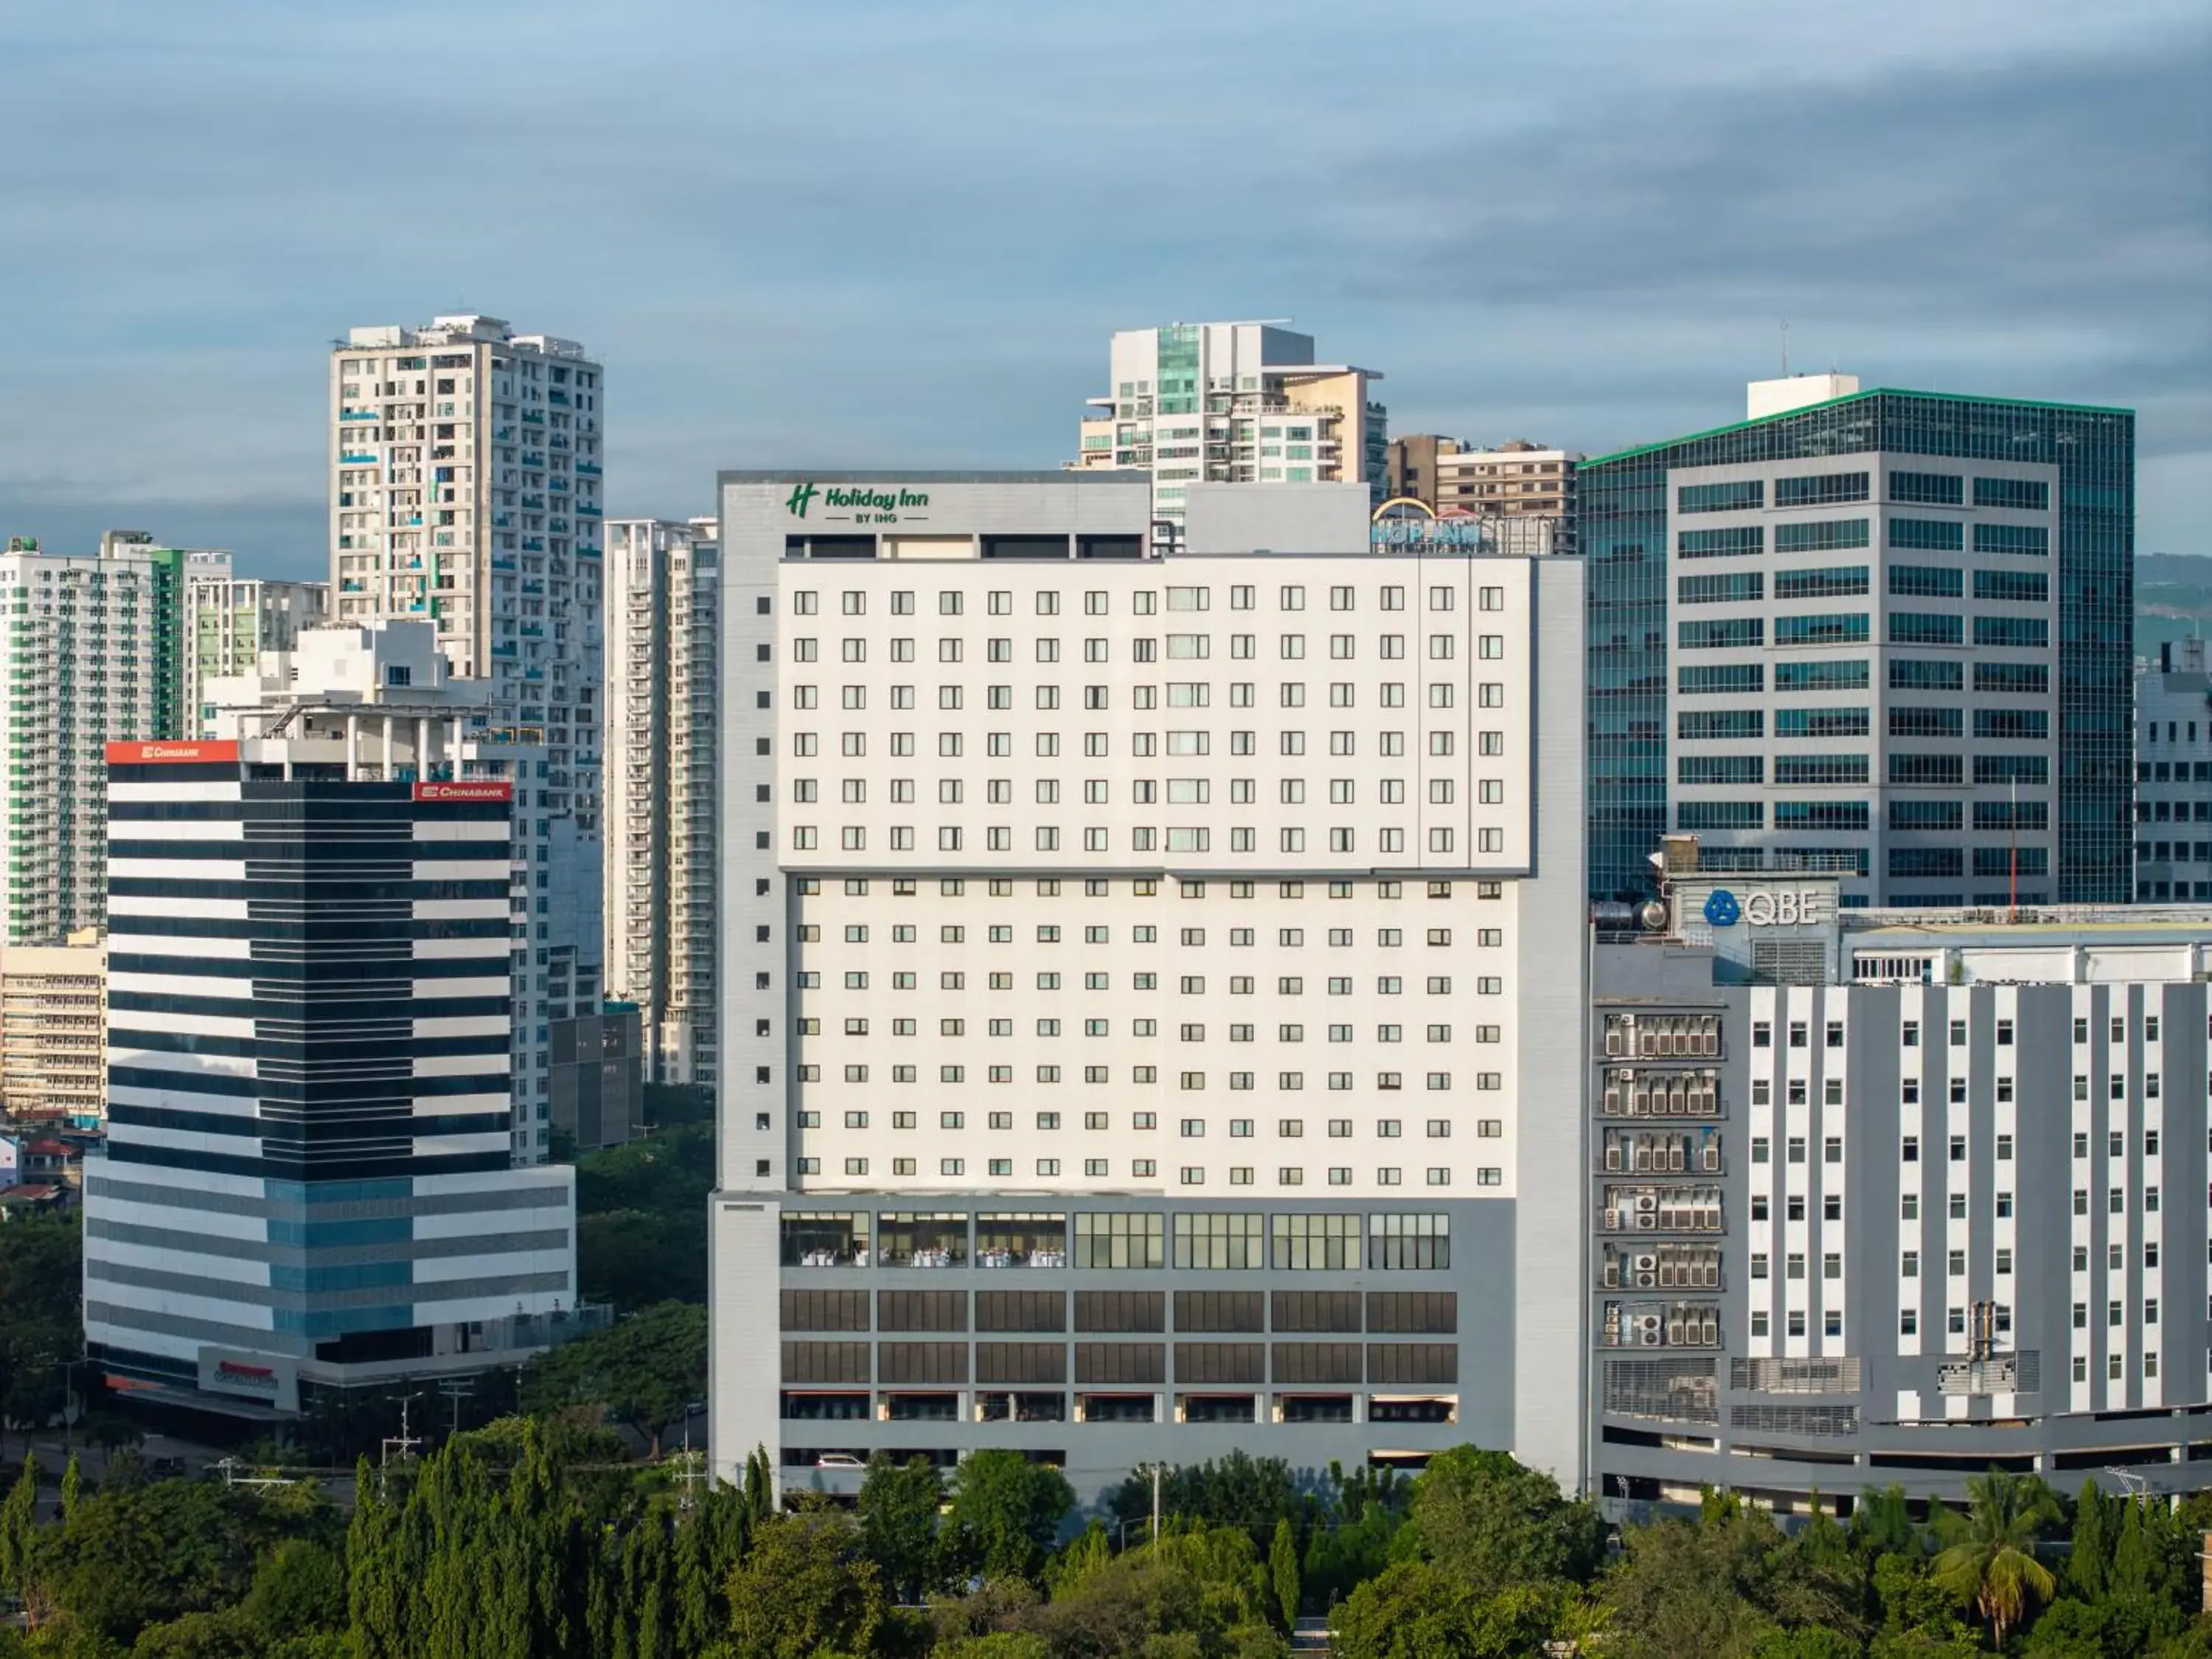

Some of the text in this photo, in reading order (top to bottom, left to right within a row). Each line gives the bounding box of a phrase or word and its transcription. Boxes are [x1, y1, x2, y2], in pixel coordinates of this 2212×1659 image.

[825, 487, 929, 510] Holiday Inn
[855, 514, 898, 524] BY IHG
[1371, 523, 1481, 543] HOP INN
[439, 787, 504, 797] CHINABANK
[1745, 890, 1818, 926] QBE
